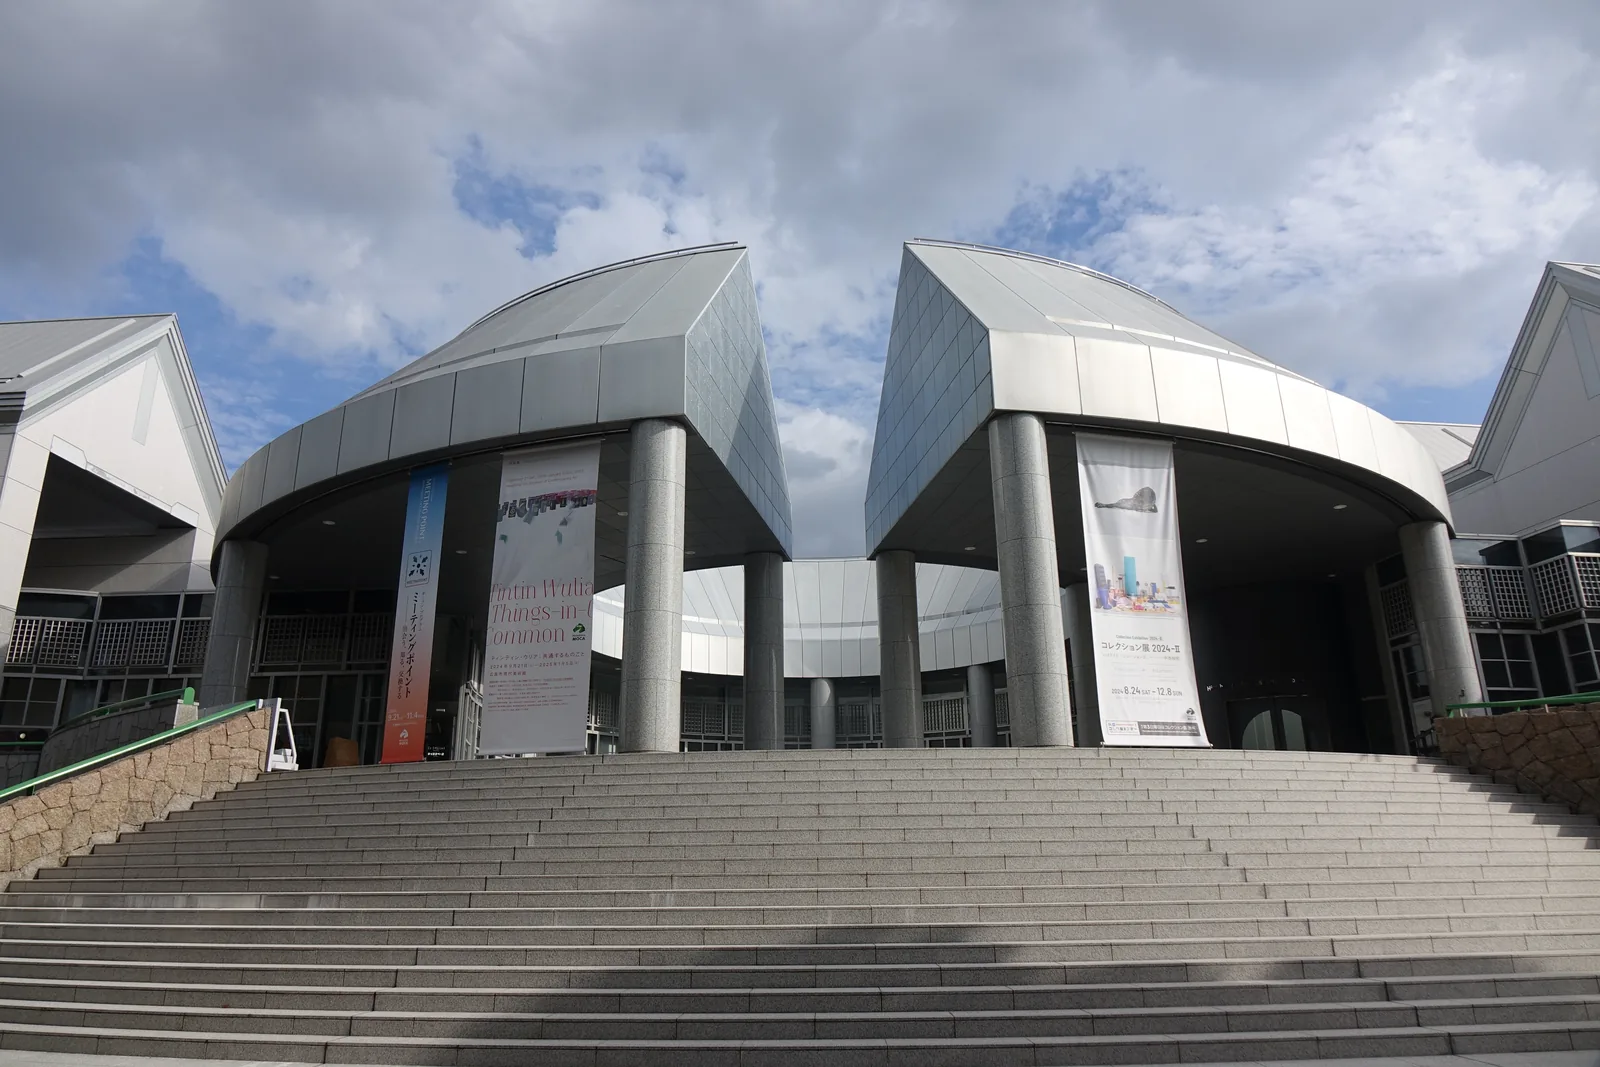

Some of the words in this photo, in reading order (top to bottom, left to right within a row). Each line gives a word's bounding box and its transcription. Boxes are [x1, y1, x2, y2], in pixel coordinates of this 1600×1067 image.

[421, 478, 432, 516] MEETING
[419, 516, 428, 540] POINT
[490, 581, 536, 602] Tintin
[543, 577, 594, 598] Wulia
[405, 592, 418, 698] ミーティングポイント
[1101, 641, 1150, 653] コレクション展
[1124, 686, 1141, 695] 8.24
[1157, 687, 1172, 696] 12.8
